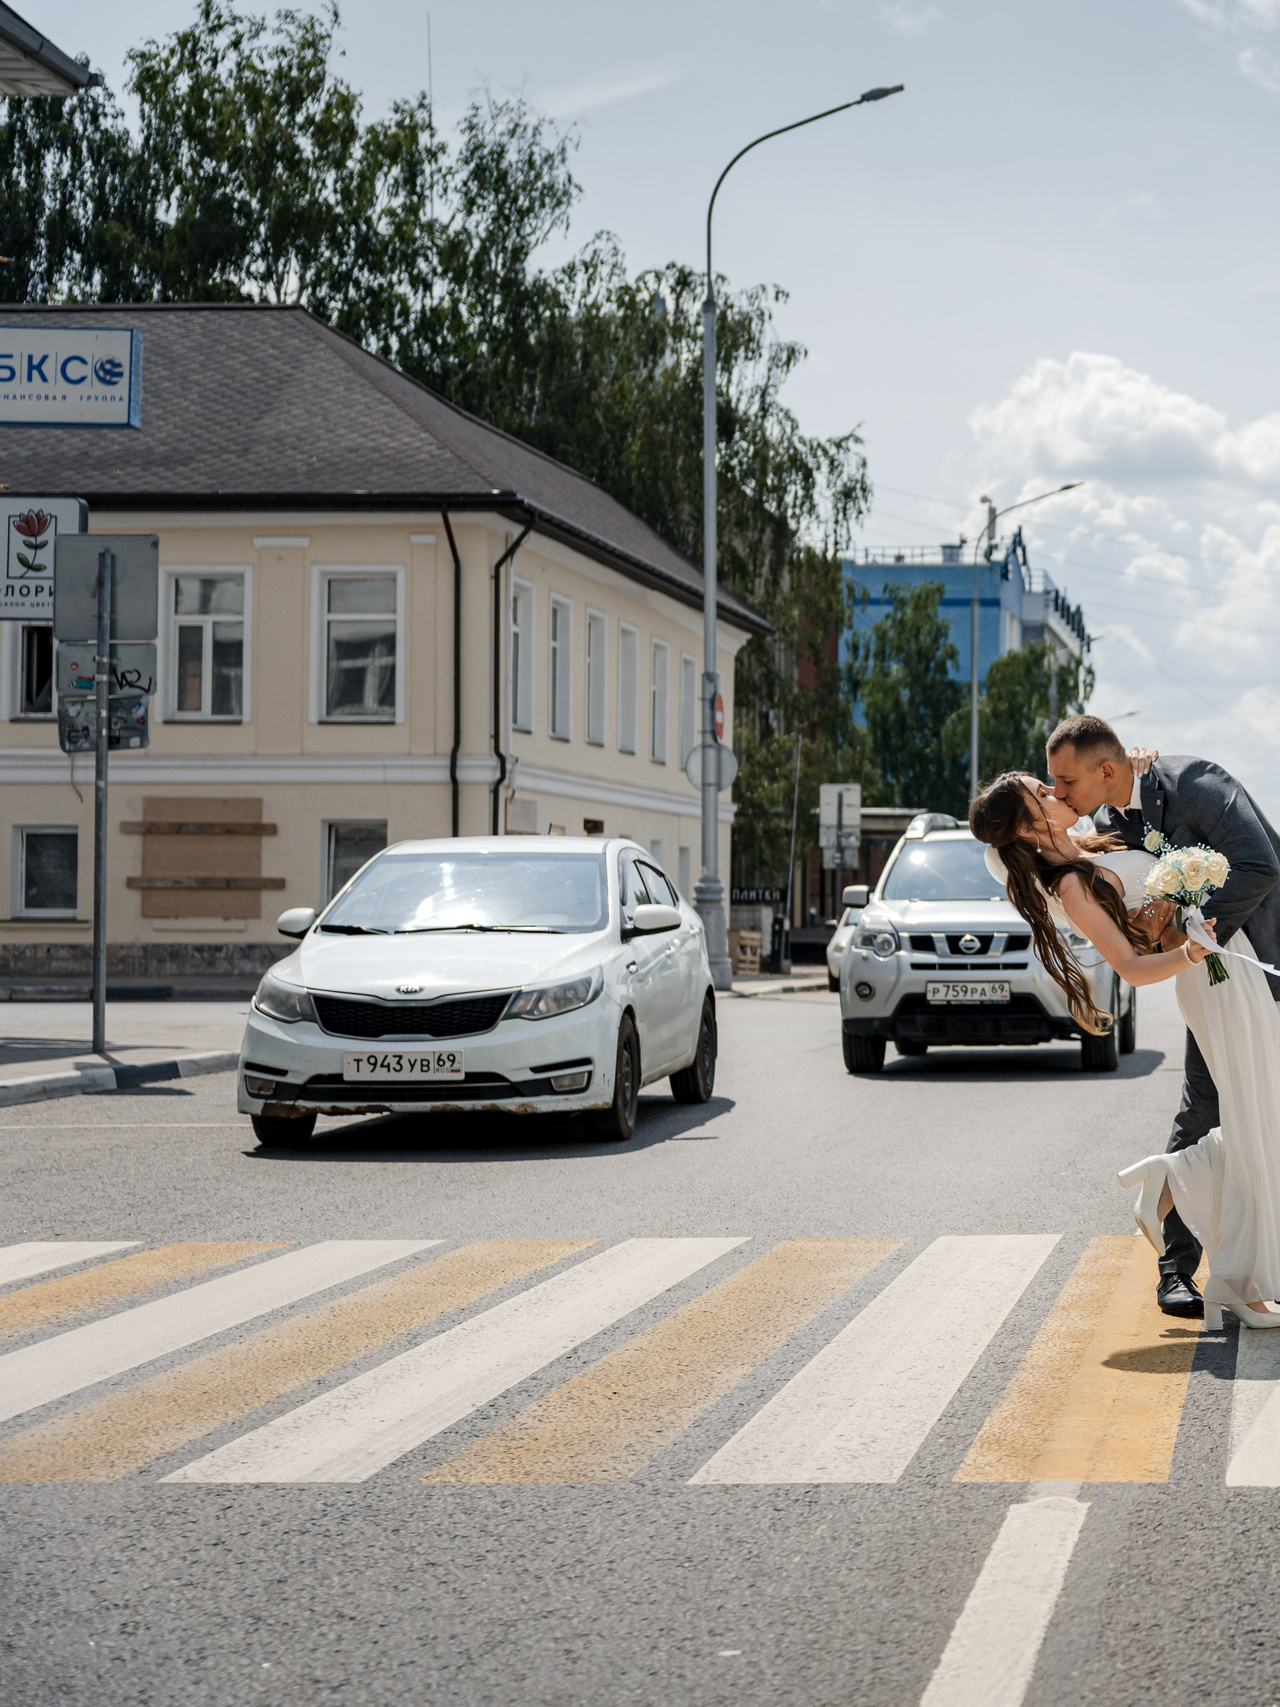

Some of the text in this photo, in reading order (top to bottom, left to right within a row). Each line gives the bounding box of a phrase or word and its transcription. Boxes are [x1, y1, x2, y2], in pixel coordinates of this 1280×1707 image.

[0, 353, 89, 385] БКС
[0, 393, 124, 402] НАНСОВАЯ ГРУППА
[0, 584, 54, 598] ЛОР
[399, 984, 421, 994] KIA
[990, 983, 1005, 995] 69
[436, 1053, 457, 1068] 69
